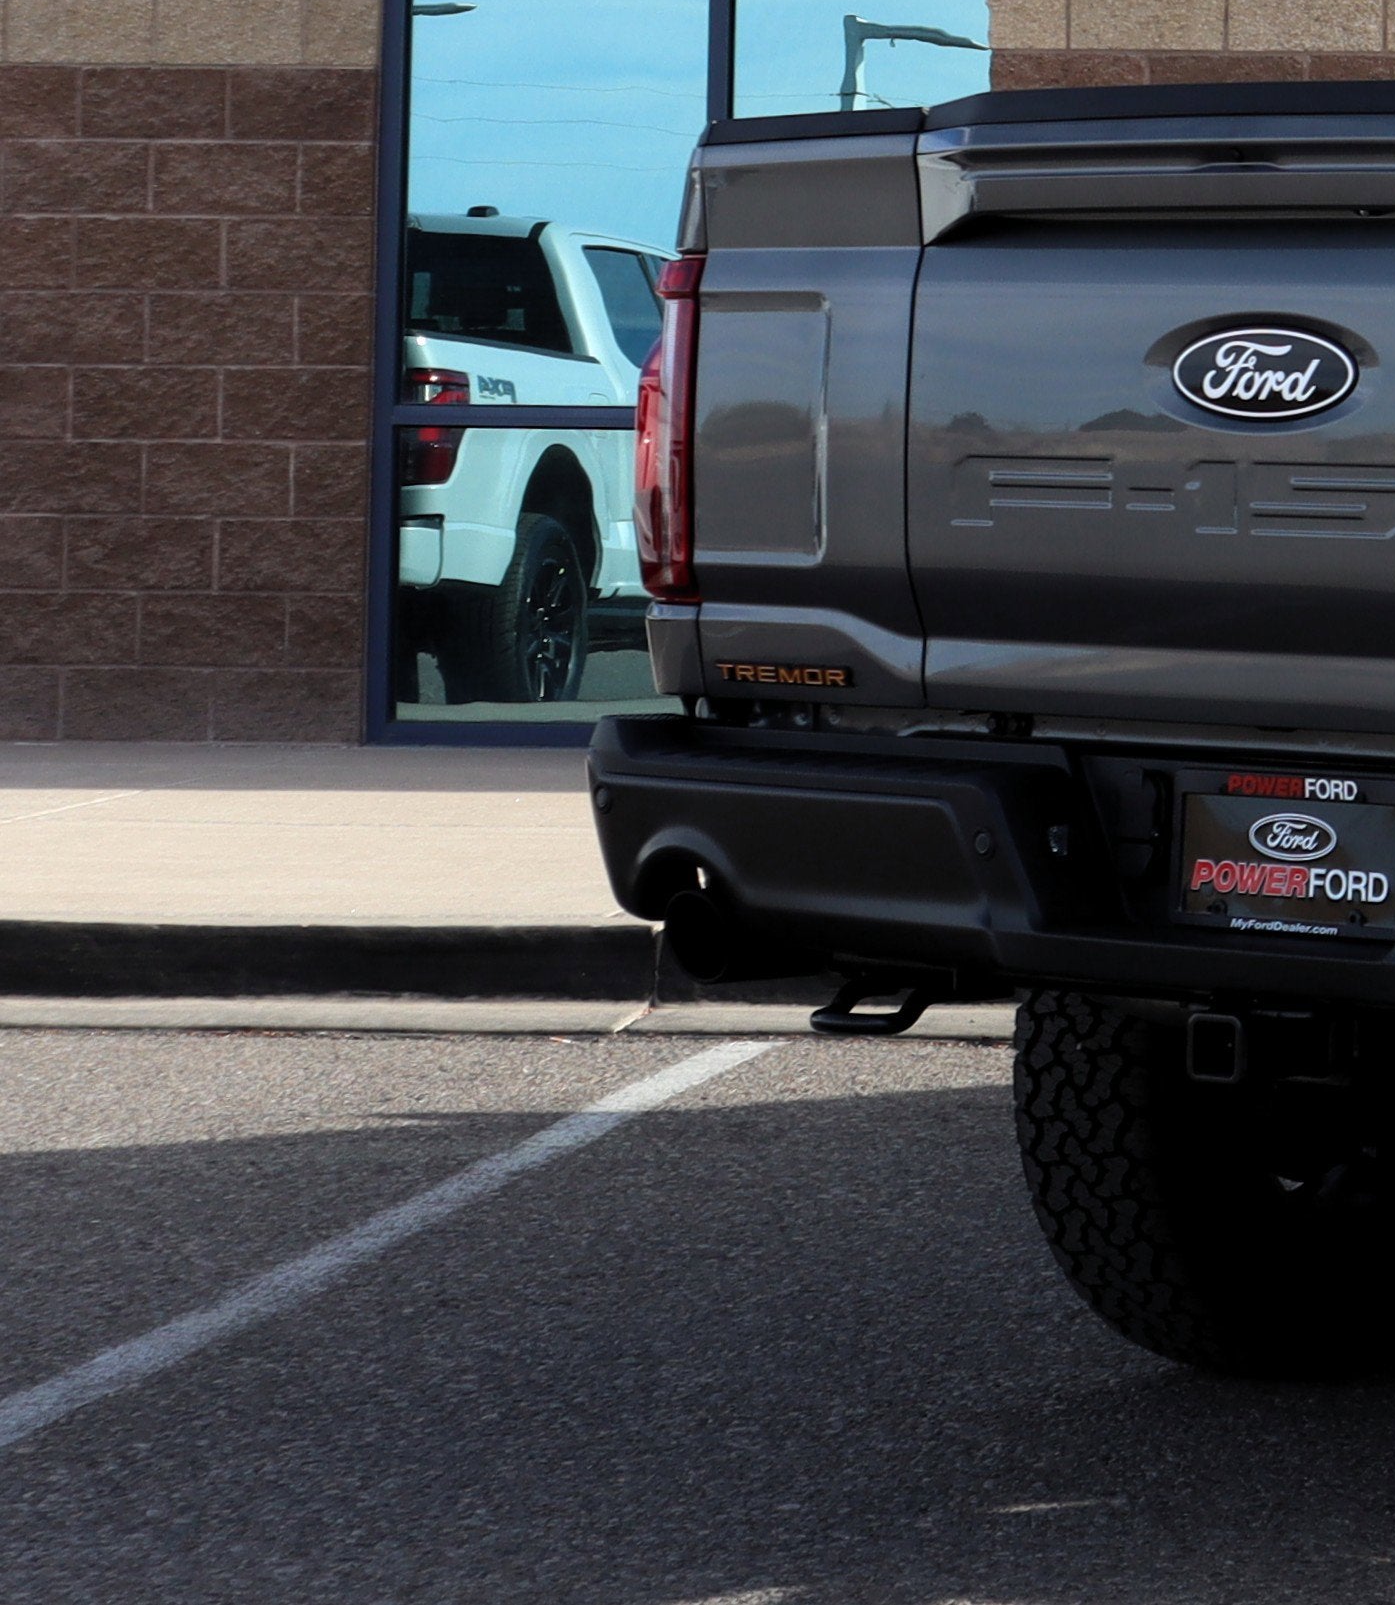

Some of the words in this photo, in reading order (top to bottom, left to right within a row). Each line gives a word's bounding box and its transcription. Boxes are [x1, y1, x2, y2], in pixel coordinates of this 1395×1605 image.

[1202, 339, 1321, 403] Ford
[715, 662, 847, 687] TREMOR
[1227, 773, 1358, 801] POWERFORD
[1266, 820, 1321, 852] Ford
[1190, 859, 1389, 903] POWERFORD
[1230, 917, 1338, 936] MyFordDealer.com
